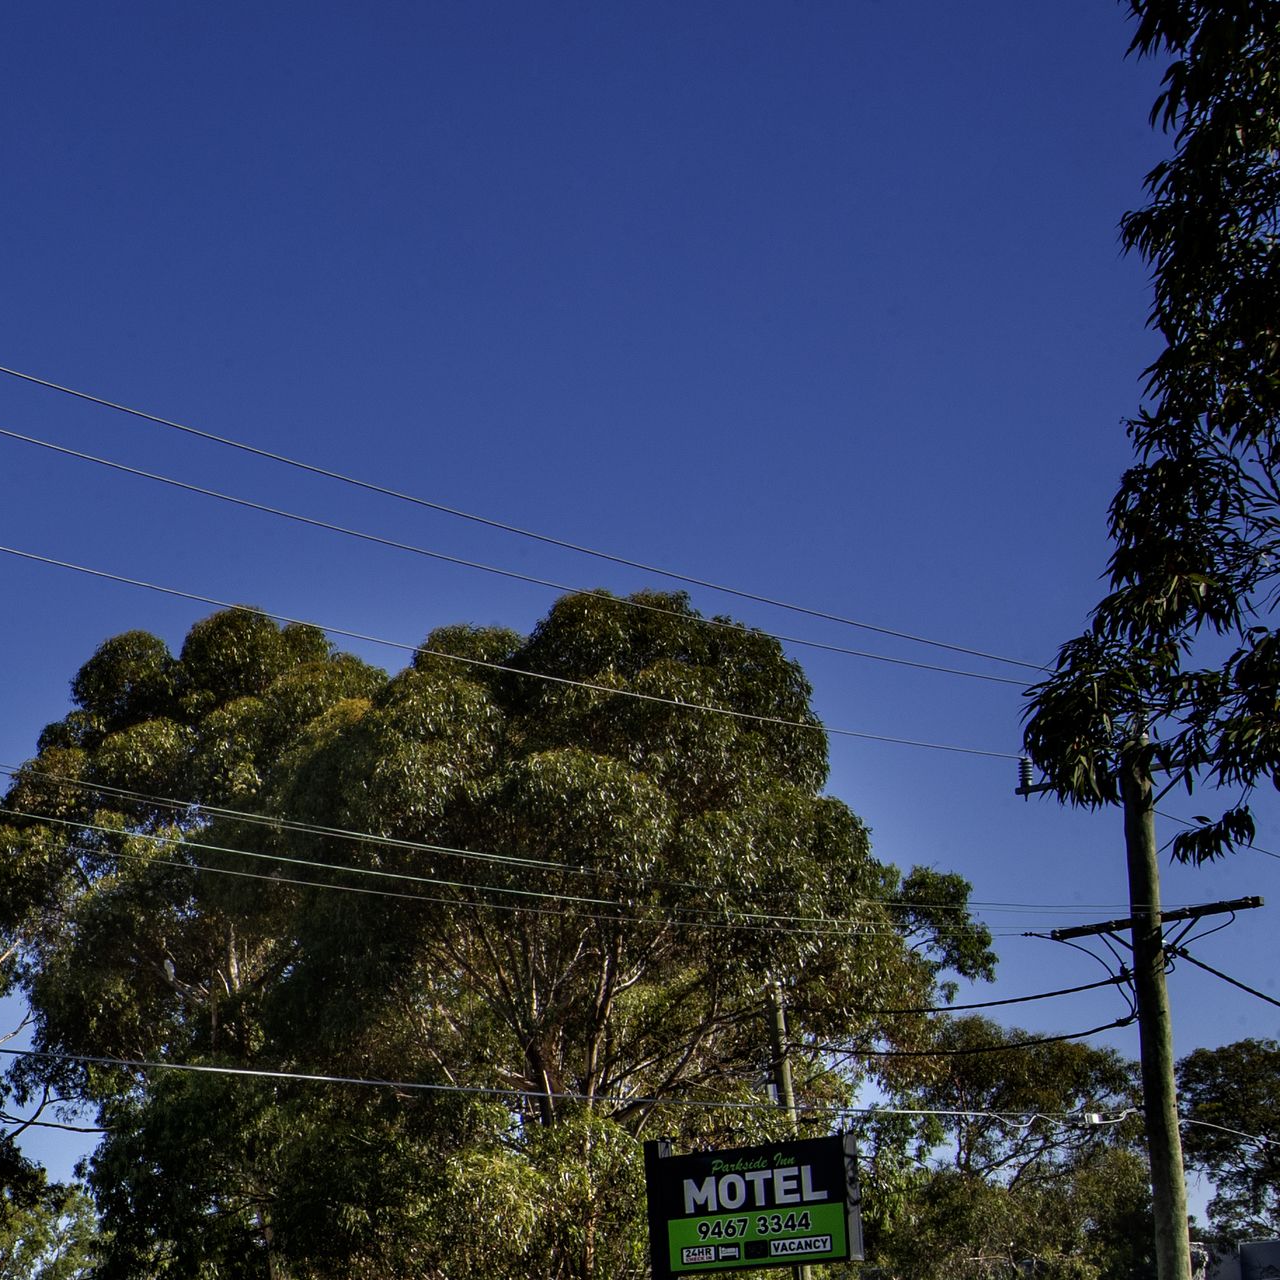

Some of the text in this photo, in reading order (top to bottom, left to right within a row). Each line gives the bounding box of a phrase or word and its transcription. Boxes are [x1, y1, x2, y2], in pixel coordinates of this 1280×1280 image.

[711, 1152, 796, 1174] Parkside Inn
[683, 1165, 828, 1214] MOTEL
[697, 1211, 811, 1241] 9467 3344
[685, 1247, 712, 1258] 24HR
[772, 1237, 829, 1253] VACANCY
